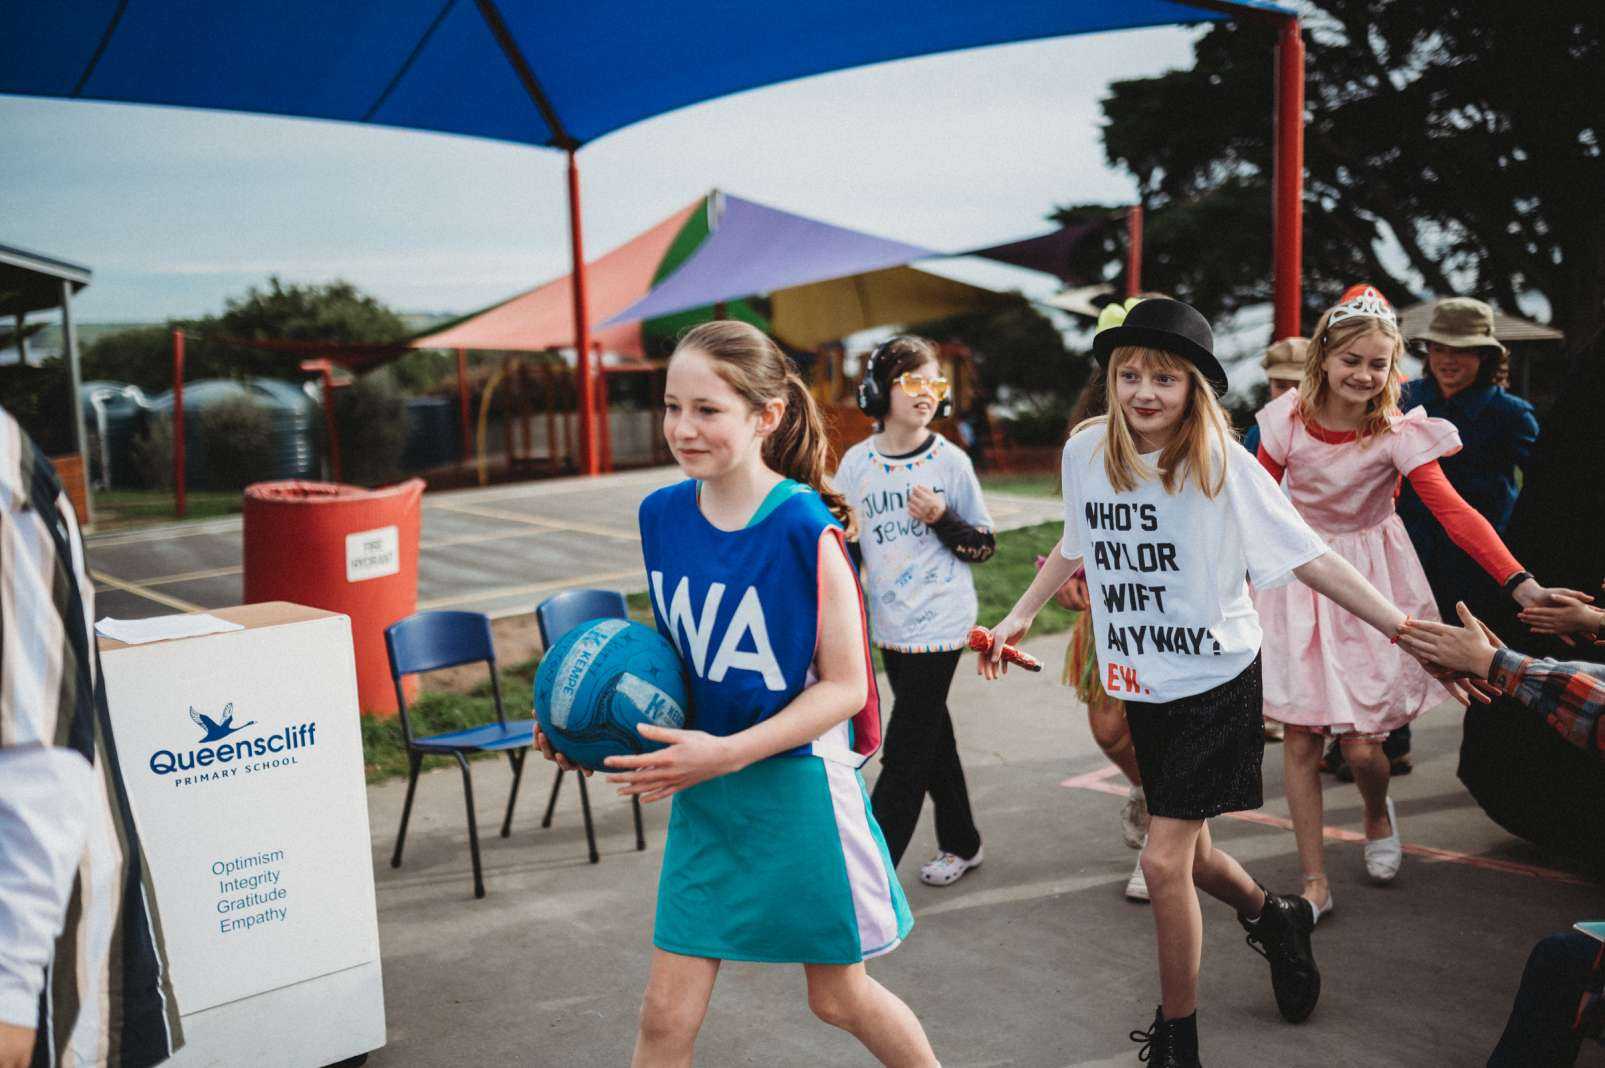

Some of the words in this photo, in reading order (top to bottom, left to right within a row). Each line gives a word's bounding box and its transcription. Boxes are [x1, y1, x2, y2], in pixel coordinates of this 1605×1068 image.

[1091, 541, 1180, 572] AYLOR
[651, 571, 787, 691] WA
[563, 650, 592, 696] KEMPE
[149, 721, 316, 775] Queenscliff
[175, 767, 238, 787] PRIMARY
[245, 756, 298, 774] SCHOOL
[212, 850, 284, 876] Optimism
[219, 870, 280, 893] Integrity
[217, 888, 287, 914] Gratitude
[220, 907, 287, 933] Empathy
